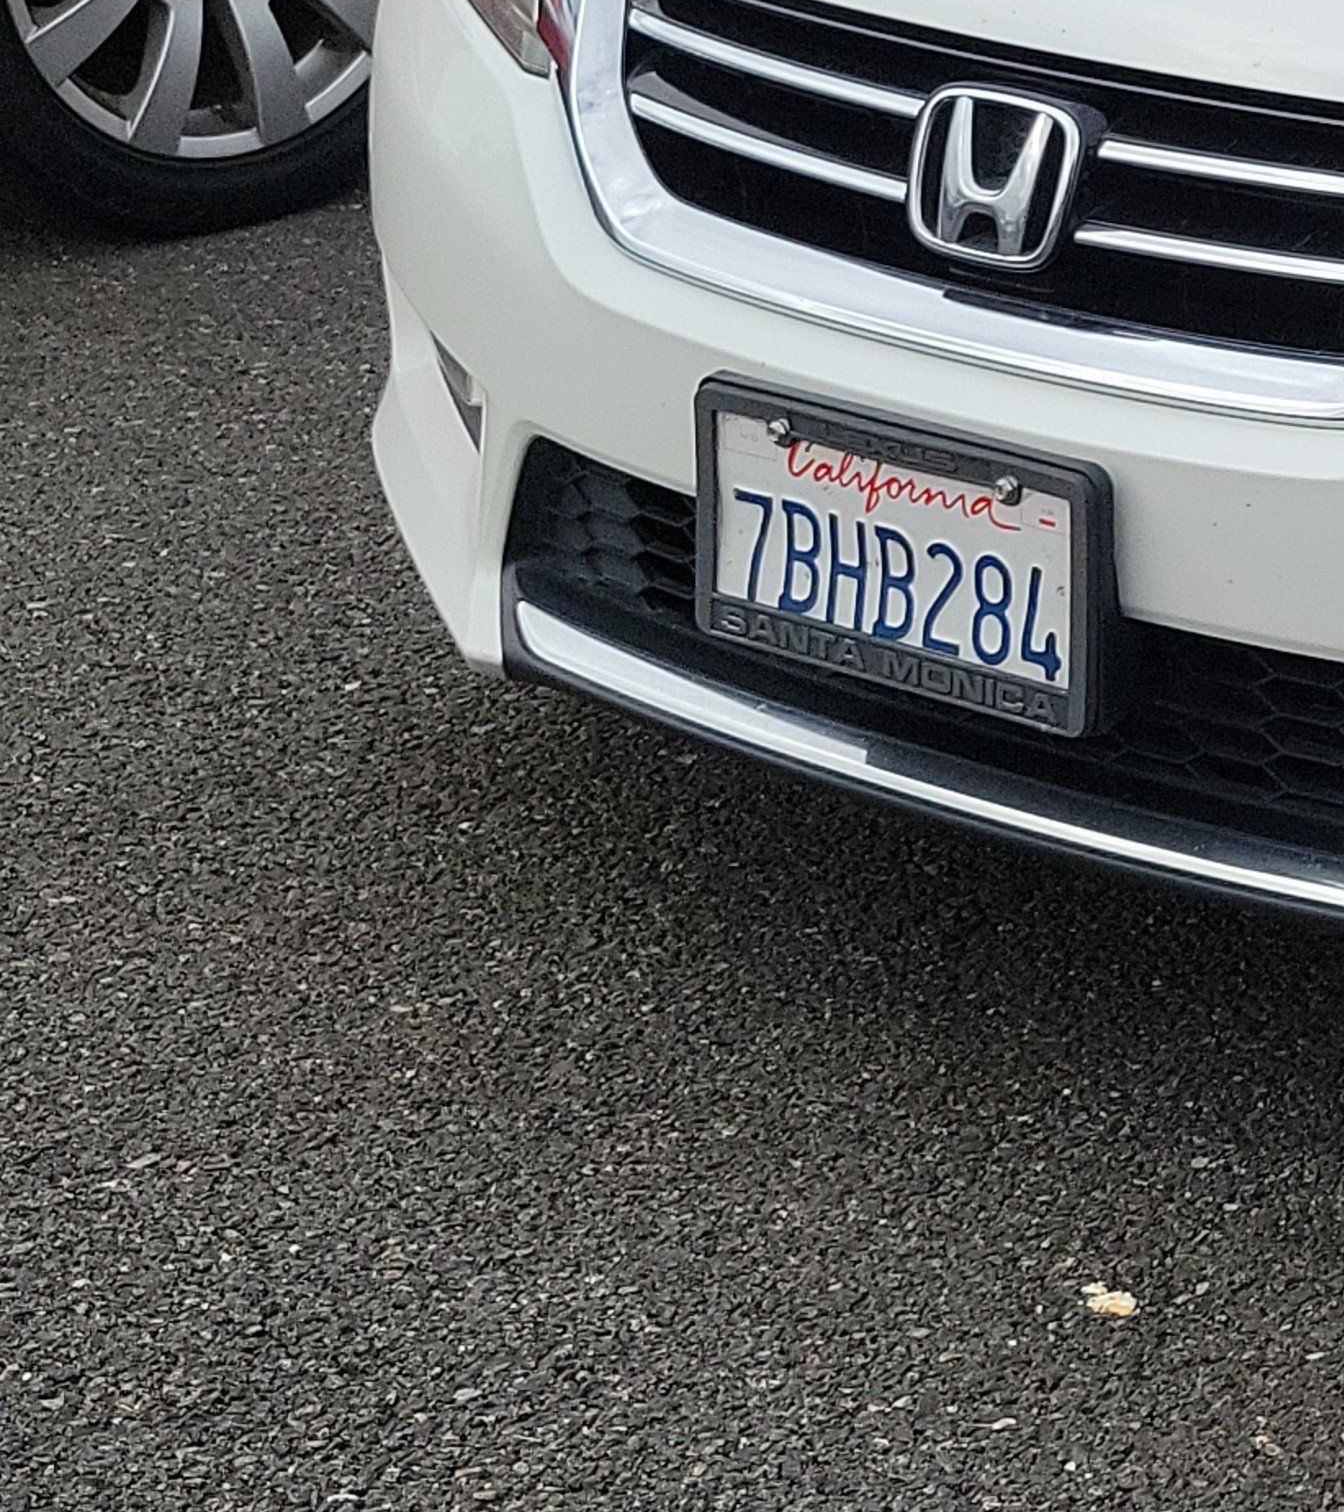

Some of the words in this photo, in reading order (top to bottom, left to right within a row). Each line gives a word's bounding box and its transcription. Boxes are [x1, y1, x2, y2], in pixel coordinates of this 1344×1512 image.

[785, 439, 1022, 531] California
[733, 487, 1062, 682] 7BHB284
[716, 609, 866, 669] SANTA
[884, 653, 1056, 722] MONICA
